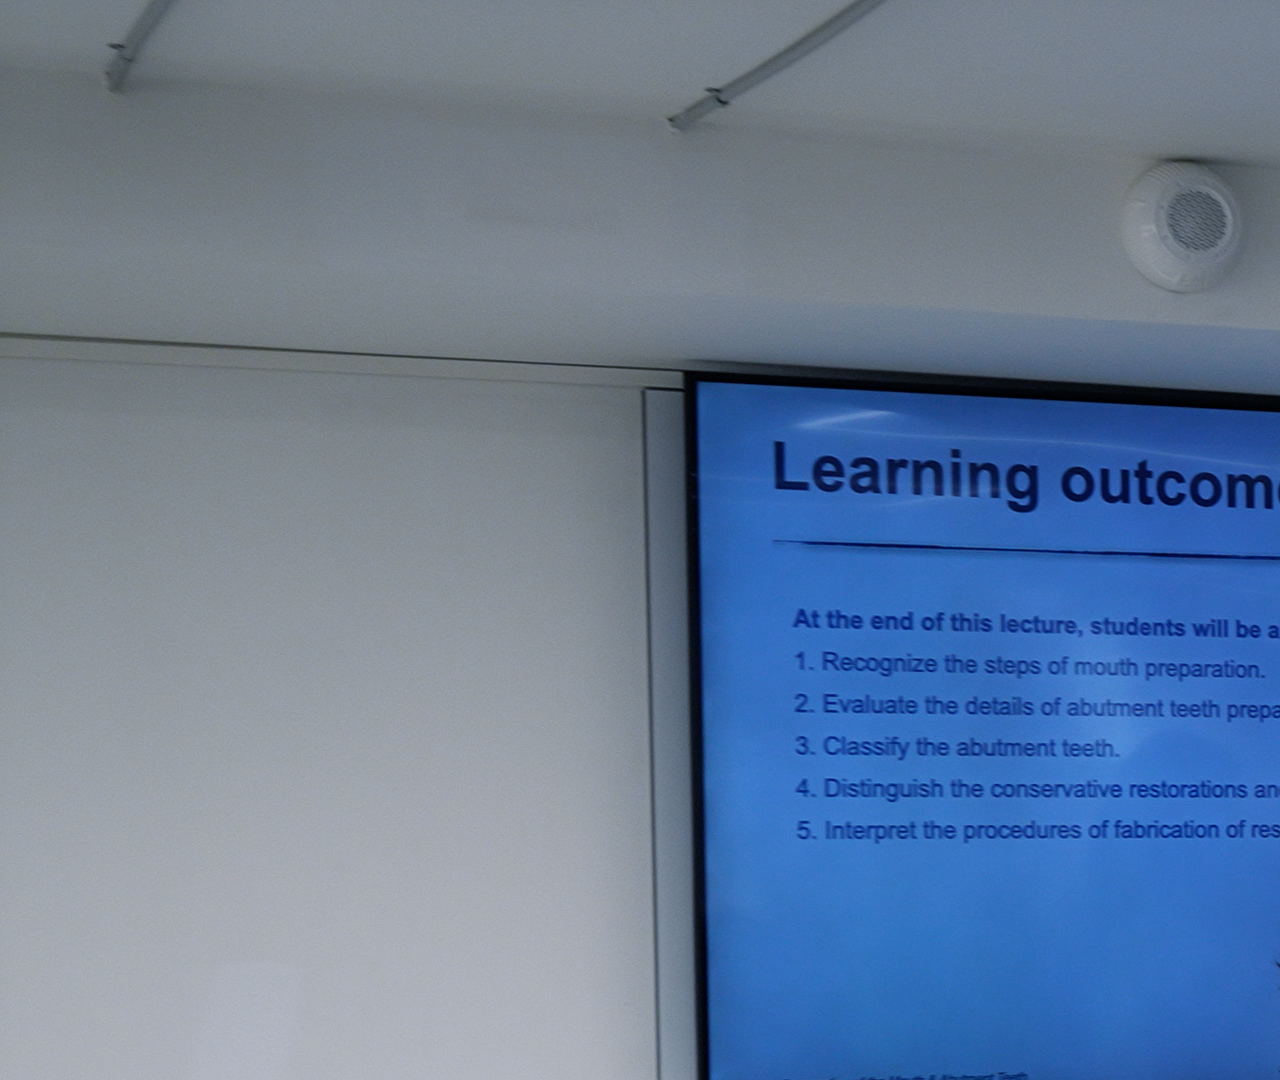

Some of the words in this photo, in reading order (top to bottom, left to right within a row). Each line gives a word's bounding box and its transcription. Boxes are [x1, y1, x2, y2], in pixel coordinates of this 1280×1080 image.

[771, 440, 1039, 513] Learning
[792, 608, 821, 629] At
[825, 609, 864, 629] the
[869, 611, 914, 630] end
[920, 612, 947, 631] of
[950, 612, 993, 632] this
[999, 614, 1083, 638] lecture,
[1090, 617, 1186, 637] students
[1191, 619, 1229, 638] will
[1235, 619, 1262, 638] be
[794, 651, 815, 671] 1.
[822, 651, 938, 677] Recognize
[943, 654, 978, 674] the
[984, 656, 1042, 679] steps
[1047, 656, 1070, 675] of
[1074, 658, 1139, 676] mouth
[1145, 659, 1266, 682] preparation.
[794, 693, 815, 713] 2.
[822, 693, 919, 714] Evaluate
[924, 695, 959, 715] the
[964, 696, 1035, 716] details
[1040, 697, 1062, 716] of
[1066, 697, 1165, 717] abutment
[1169, 699, 1221, 718] teeth
[795, 736, 816, 755] 3.
[823, 736, 911, 761] Classify
[915, 737, 950, 756] the
[956, 737, 1057, 757] abutment
[1061, 739, 1120, 757] teeth.
[795, 778, 817, 798] 4.
[823, 778, 944, 803] Distinguish
[949, 779, 985, 798] the
[990, 779, 1123, 798] conservative
[1129, 780, 1248, 798] restorations
[796, 820, 817, 840] 5.
[825, 820, 917, 844] Interpret
[922, 820, 957, 840] the
[963, 820, 1082, 844] procedures
[1088, 820, 1109, 839] of
[1113, 820, 1221, 839] fabrication
[1225, 819, 1247, 838] of
